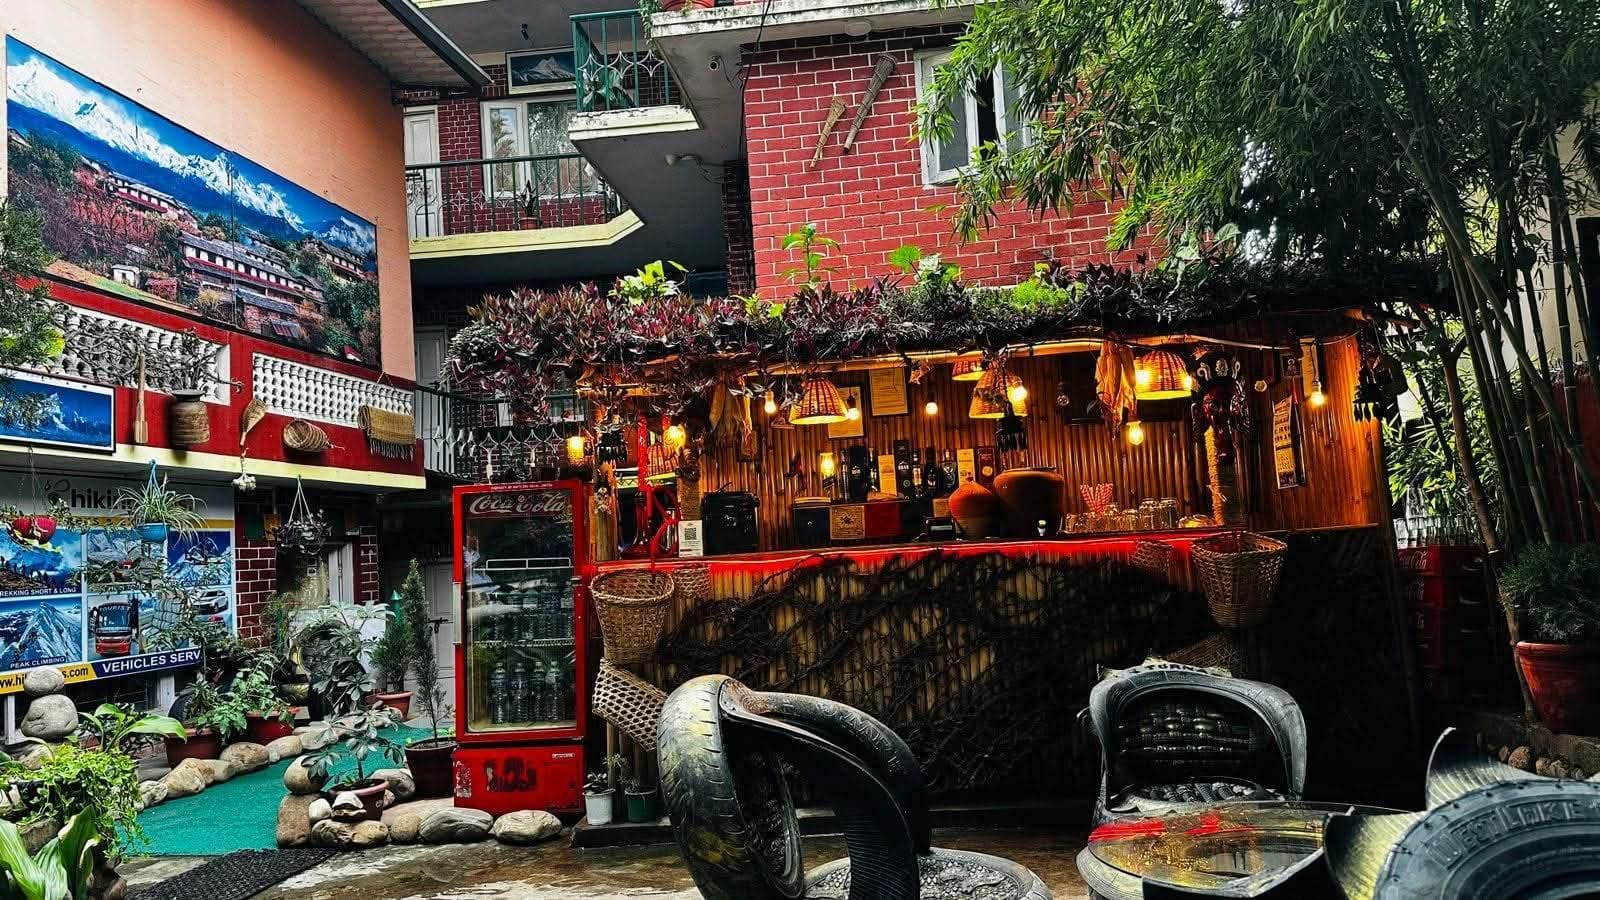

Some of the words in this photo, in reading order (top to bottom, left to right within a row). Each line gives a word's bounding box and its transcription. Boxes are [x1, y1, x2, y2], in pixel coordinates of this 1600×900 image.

[10, 661, 30, 669] PEAK
[32, 656, 65, 666] CLIMBING
[102, 655, 166, 673] VEHICLES
